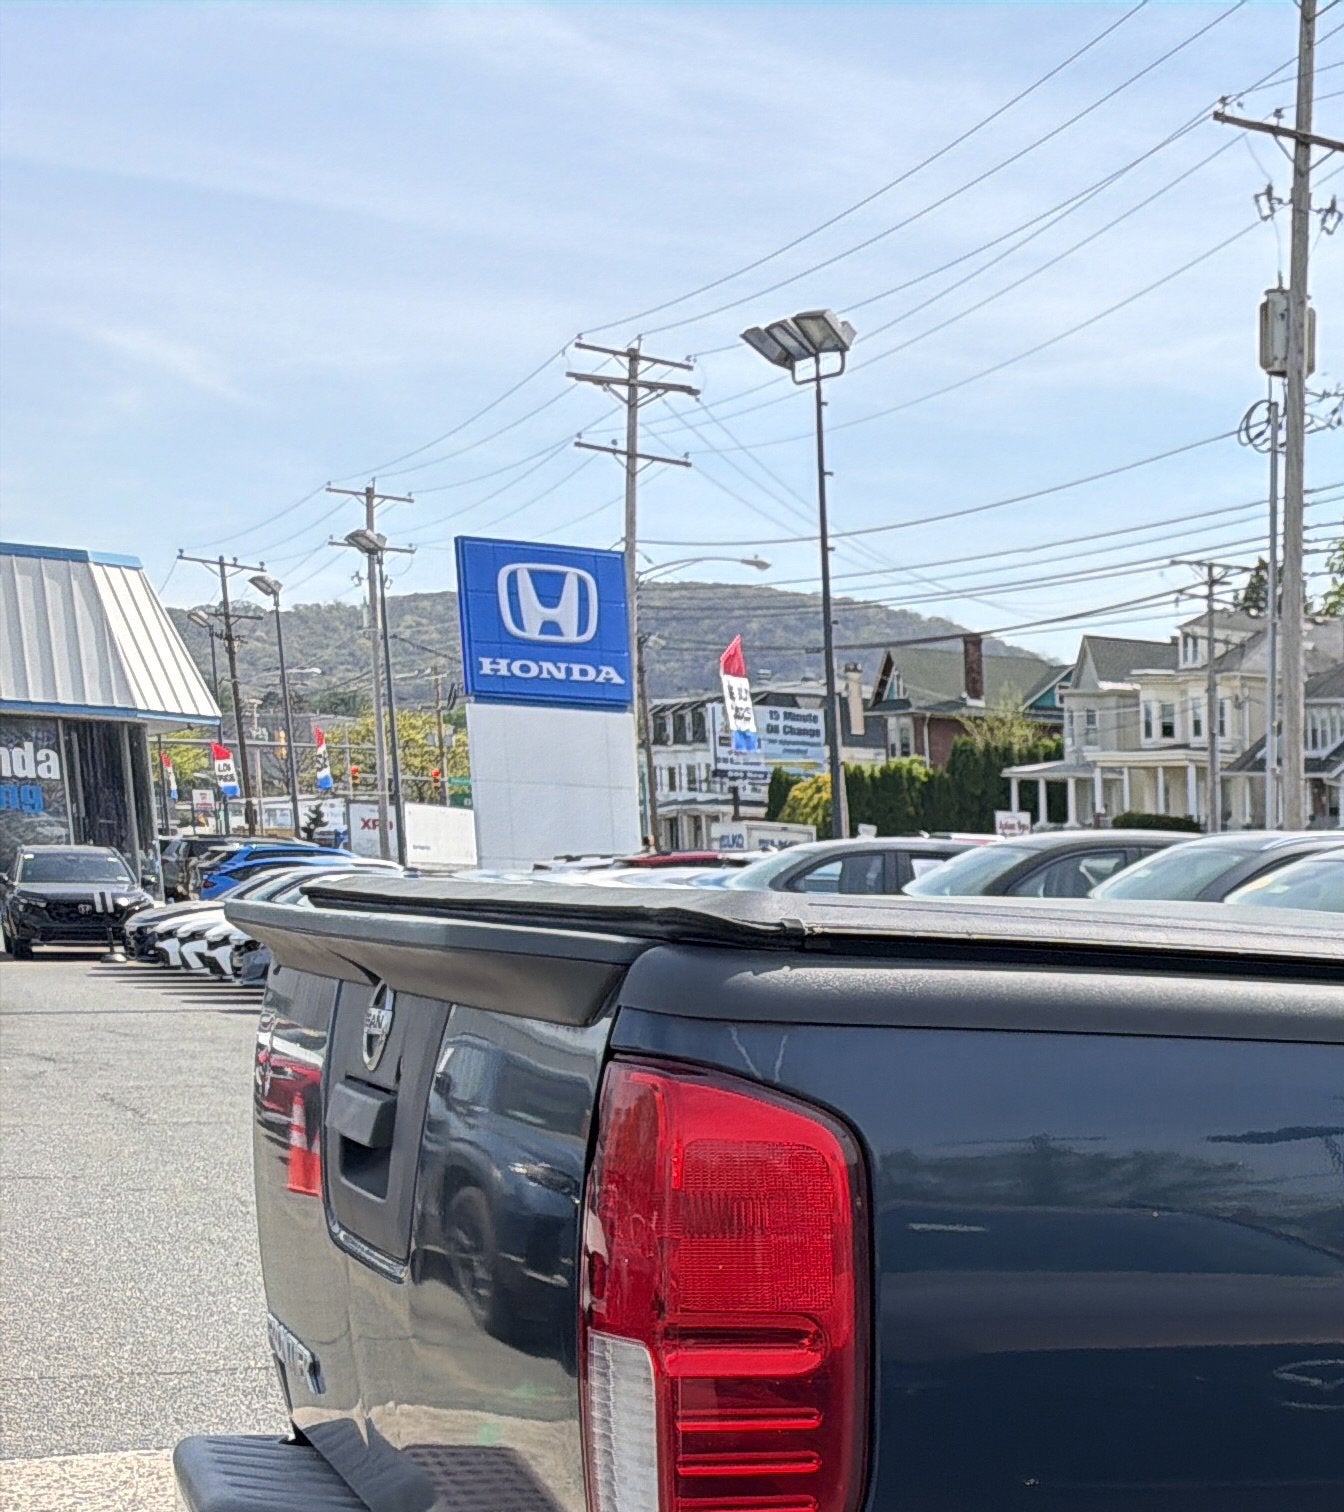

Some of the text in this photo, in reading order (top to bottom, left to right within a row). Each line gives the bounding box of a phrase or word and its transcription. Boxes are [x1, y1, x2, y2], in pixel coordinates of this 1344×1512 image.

[479, 657, 625, 684] HONDA
[783, 711, 818, 724] Minute
[783, 724, 821, 738] Change
